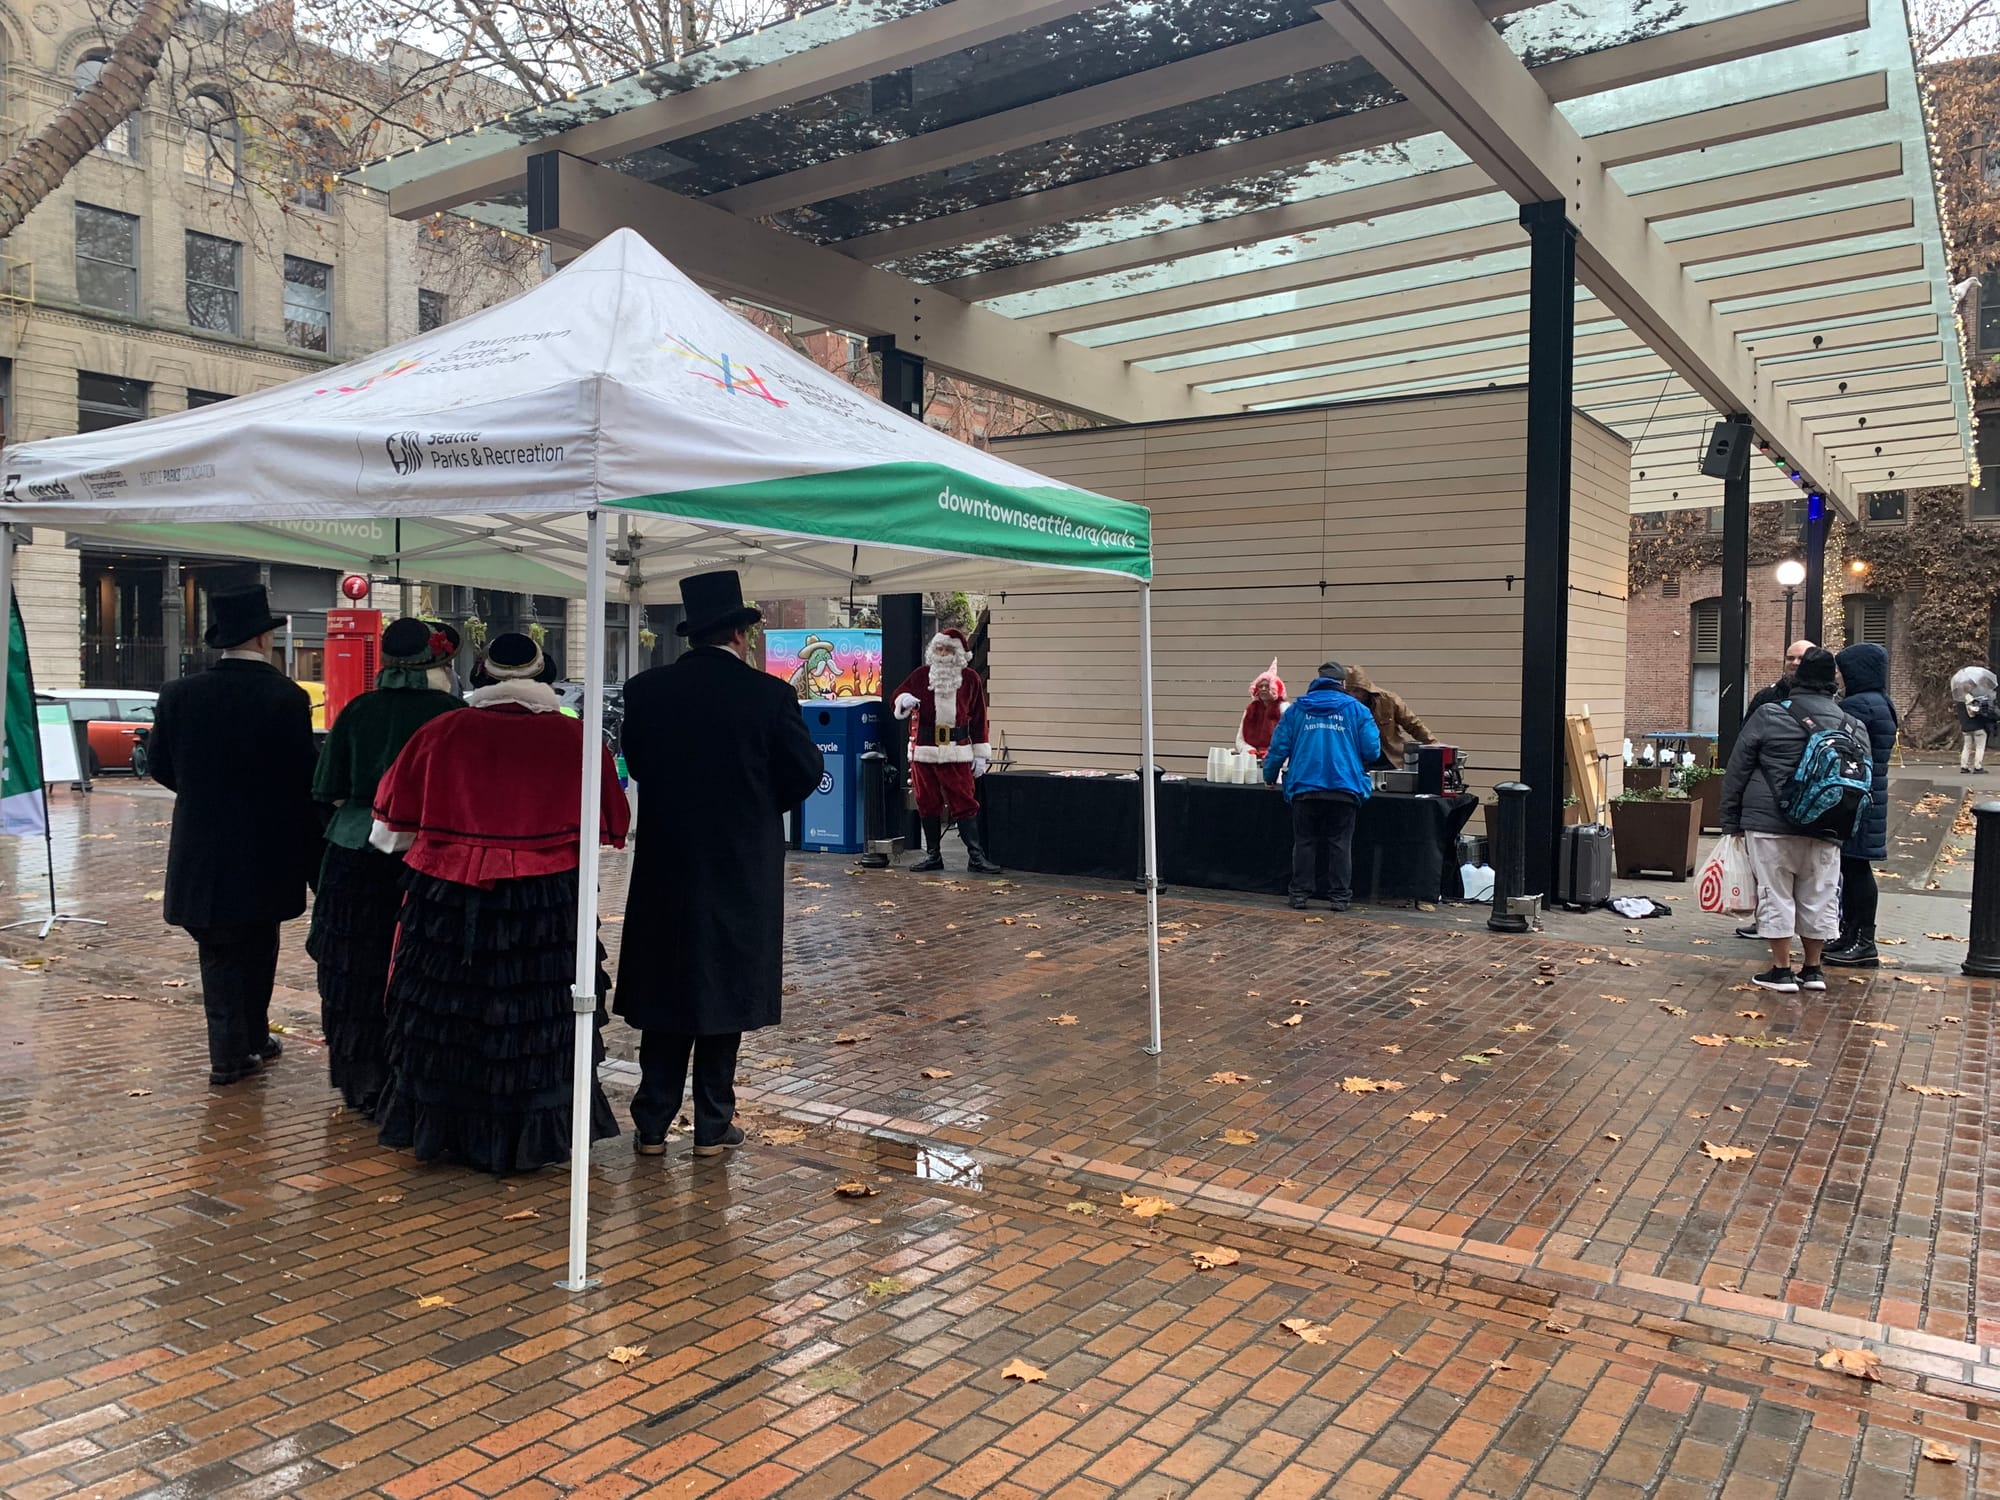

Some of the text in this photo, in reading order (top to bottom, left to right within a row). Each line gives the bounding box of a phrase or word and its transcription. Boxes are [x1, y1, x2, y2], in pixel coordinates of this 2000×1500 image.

[431, 443, 565, 469] Parks & Recreation
[938, 486, 1136, 549] downtownseattle.org/parks
[816, 742, 838, 753] cycle
